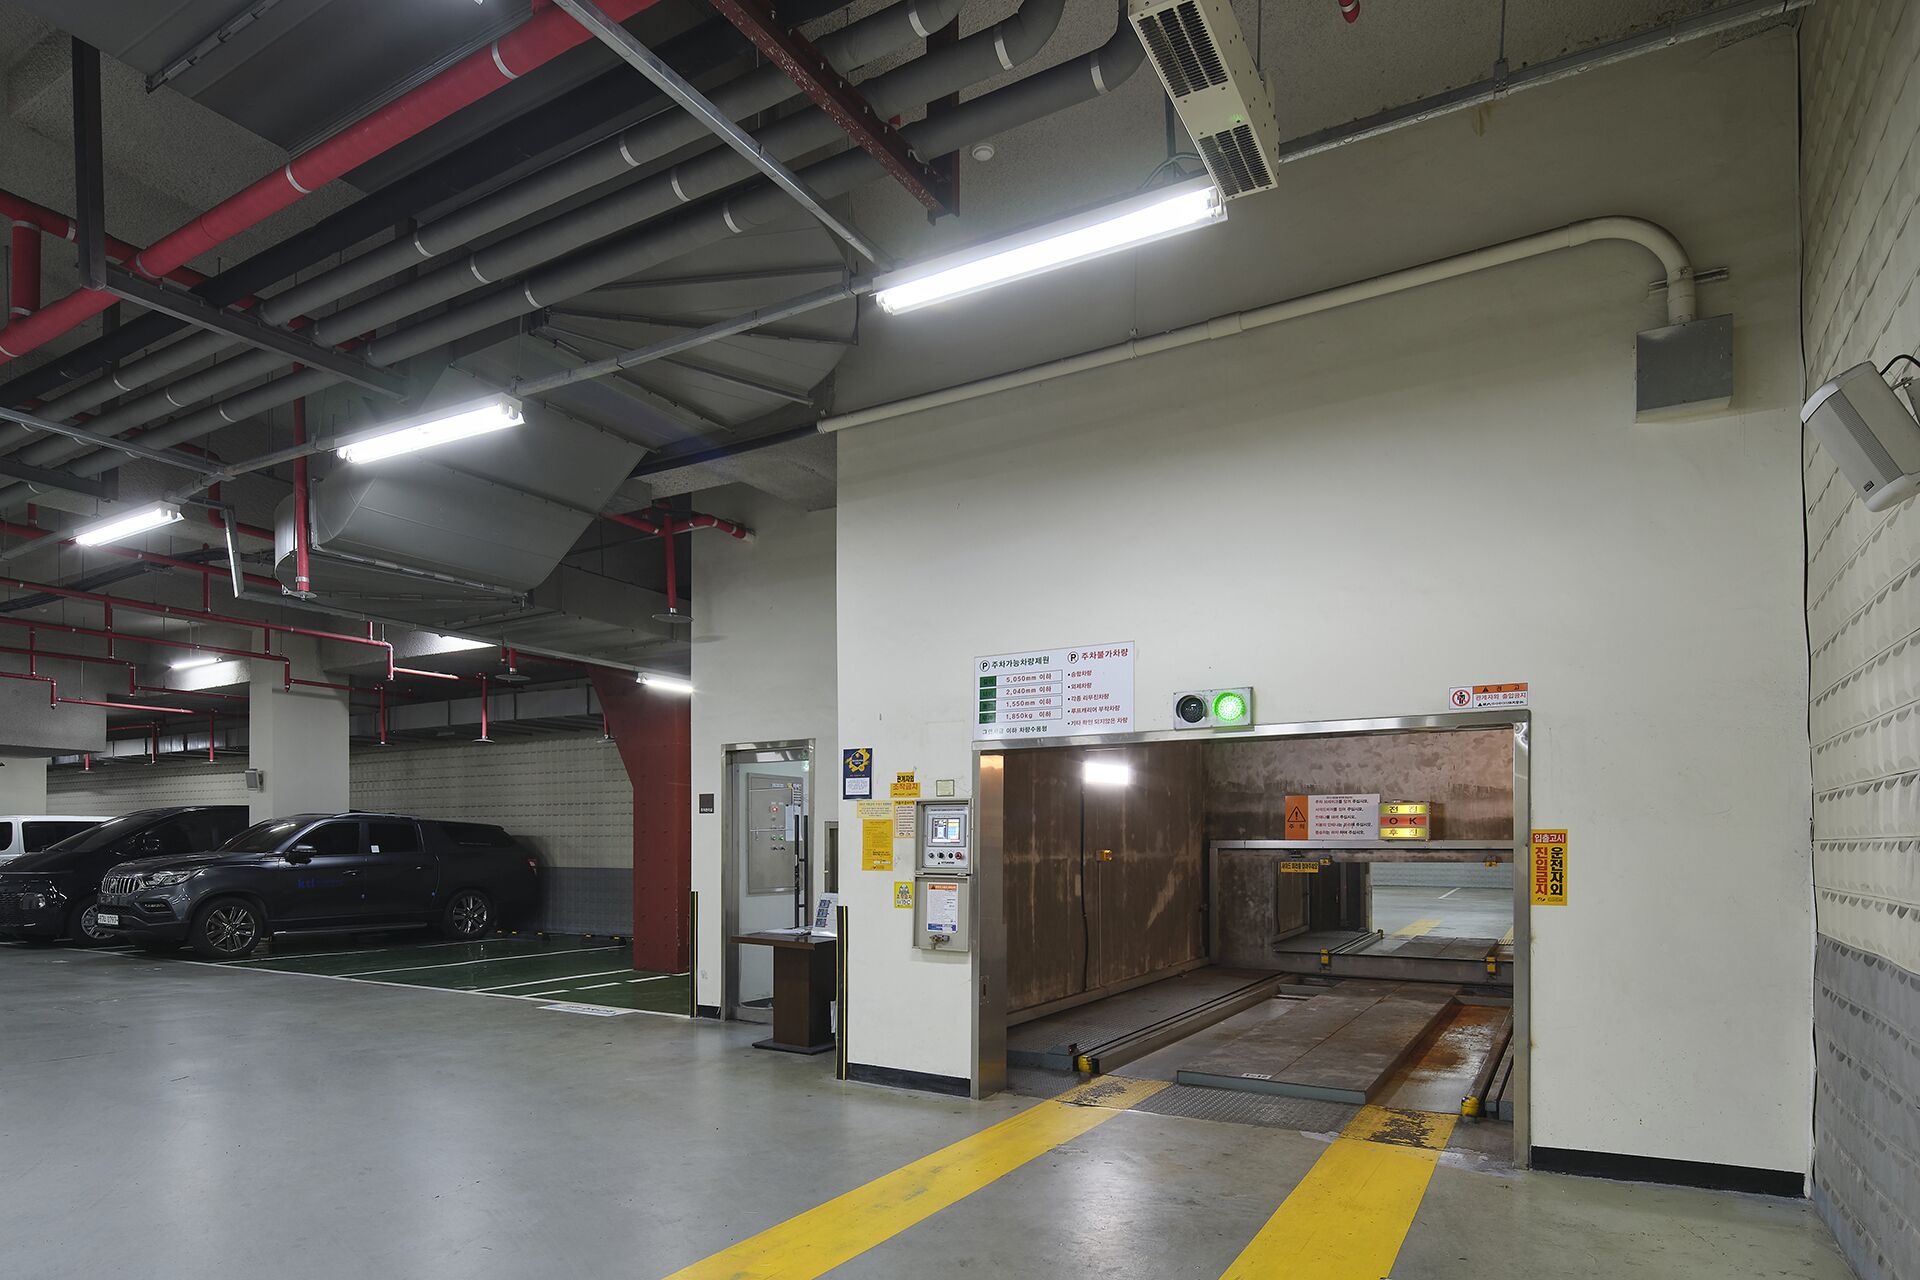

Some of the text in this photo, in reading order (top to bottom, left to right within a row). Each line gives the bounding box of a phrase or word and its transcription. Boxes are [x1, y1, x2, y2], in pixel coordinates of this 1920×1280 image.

[1082, 648, 1128, 660] 주차불가차량
[992, 656, 1049, 668] 주차가능차량제원
[1535, 834, 1564, 843] 입출고시
[1536, 847, 1548, 895] 진입금지
[1550, 847, 1564, 896] 운전자외
